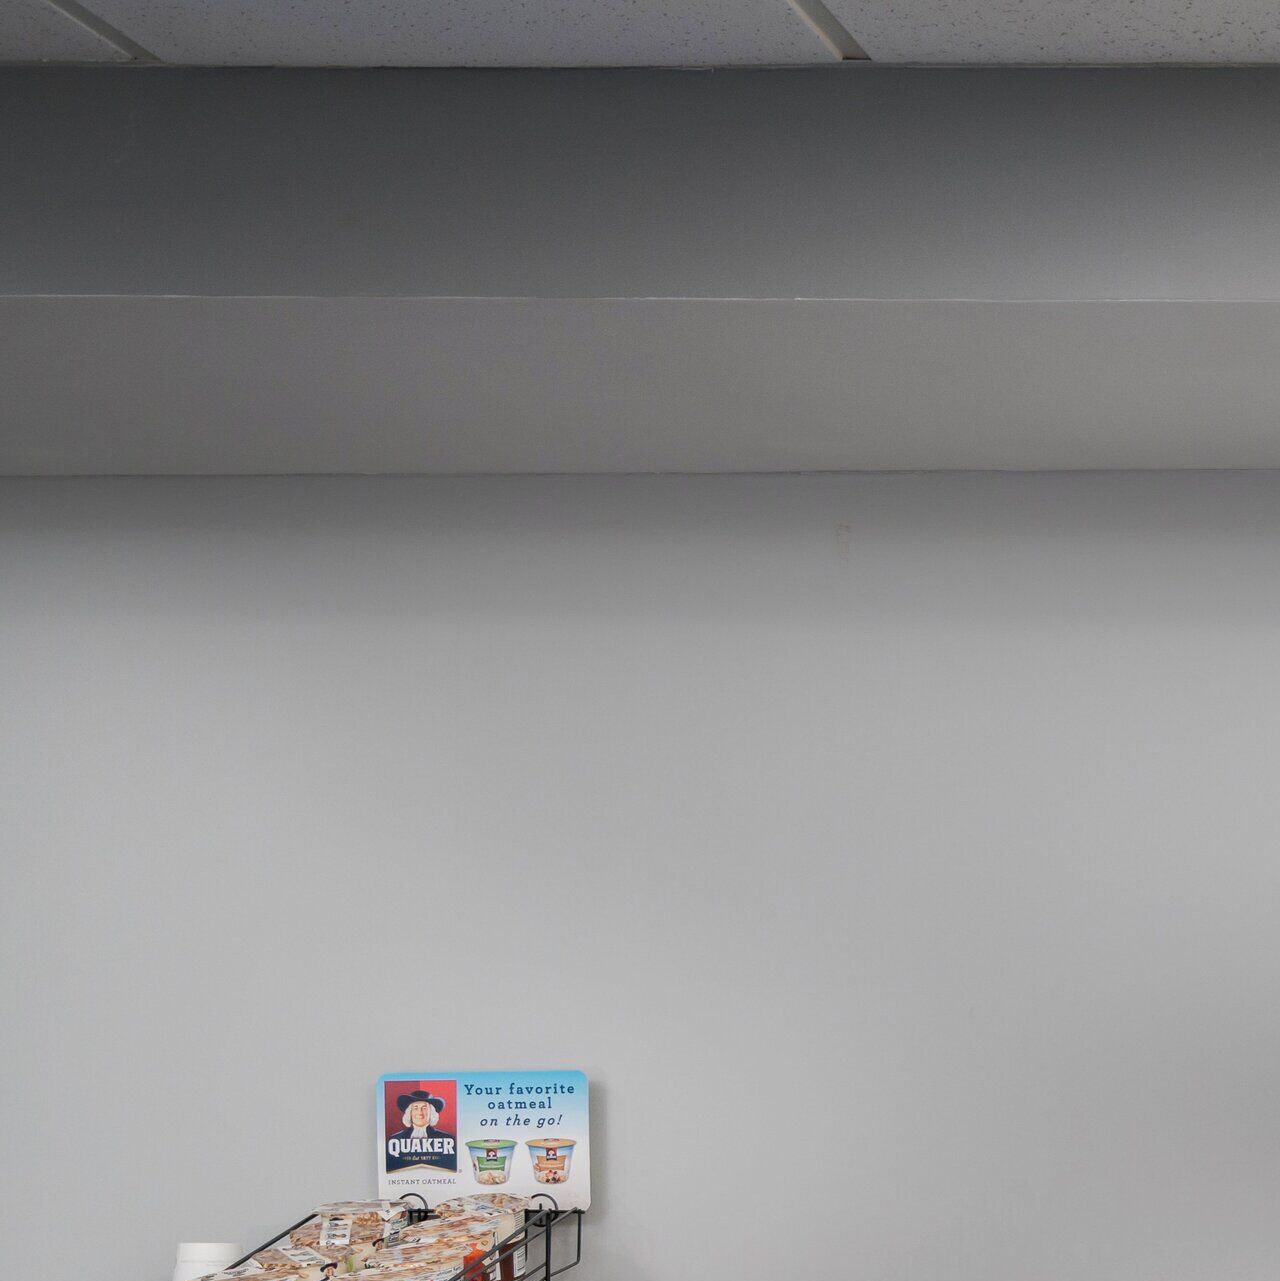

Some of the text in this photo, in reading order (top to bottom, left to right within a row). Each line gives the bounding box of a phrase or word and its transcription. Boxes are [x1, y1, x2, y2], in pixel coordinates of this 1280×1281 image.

[464, 1082, 575, 1095] Your favorite
[487, 1097, 553, 1109] oatmeal
[480, 1114, 563, 1128] on the go!
[388, 1137, 455, 1157] QUAKER
